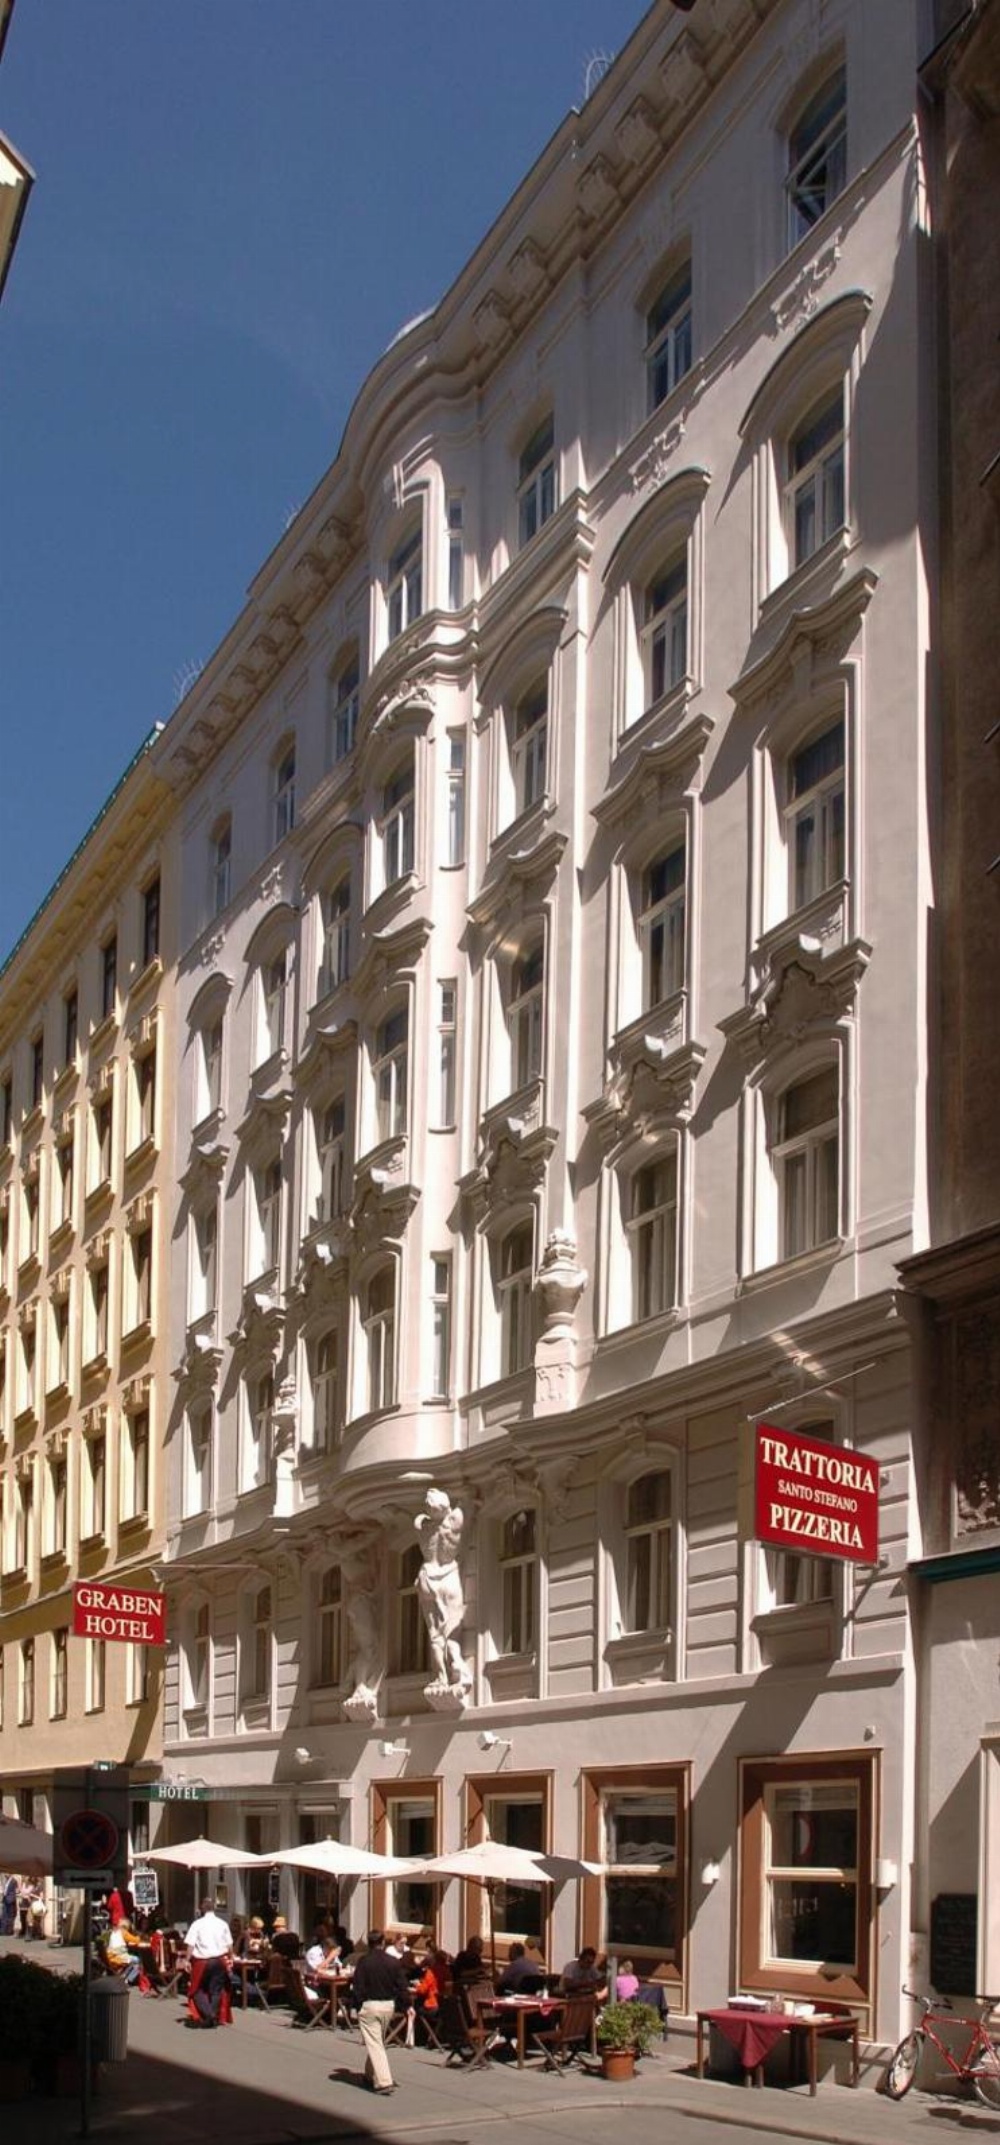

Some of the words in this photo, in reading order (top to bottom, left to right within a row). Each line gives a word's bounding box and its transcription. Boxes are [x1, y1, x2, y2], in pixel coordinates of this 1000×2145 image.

[760, 1437, 875, 1494] TRATTORIA
[778, 1479, 813, 1501] SANTO
[814, 1490, 858, 1513] STEFANO
[770, 1503, 864, 1549] PIZZERIA
[77, 1588, 162, 1616] GRABEN
[85, 1614, 154, 1639] HOTEL
[158, 1786, 199, 1800] HOTEL
